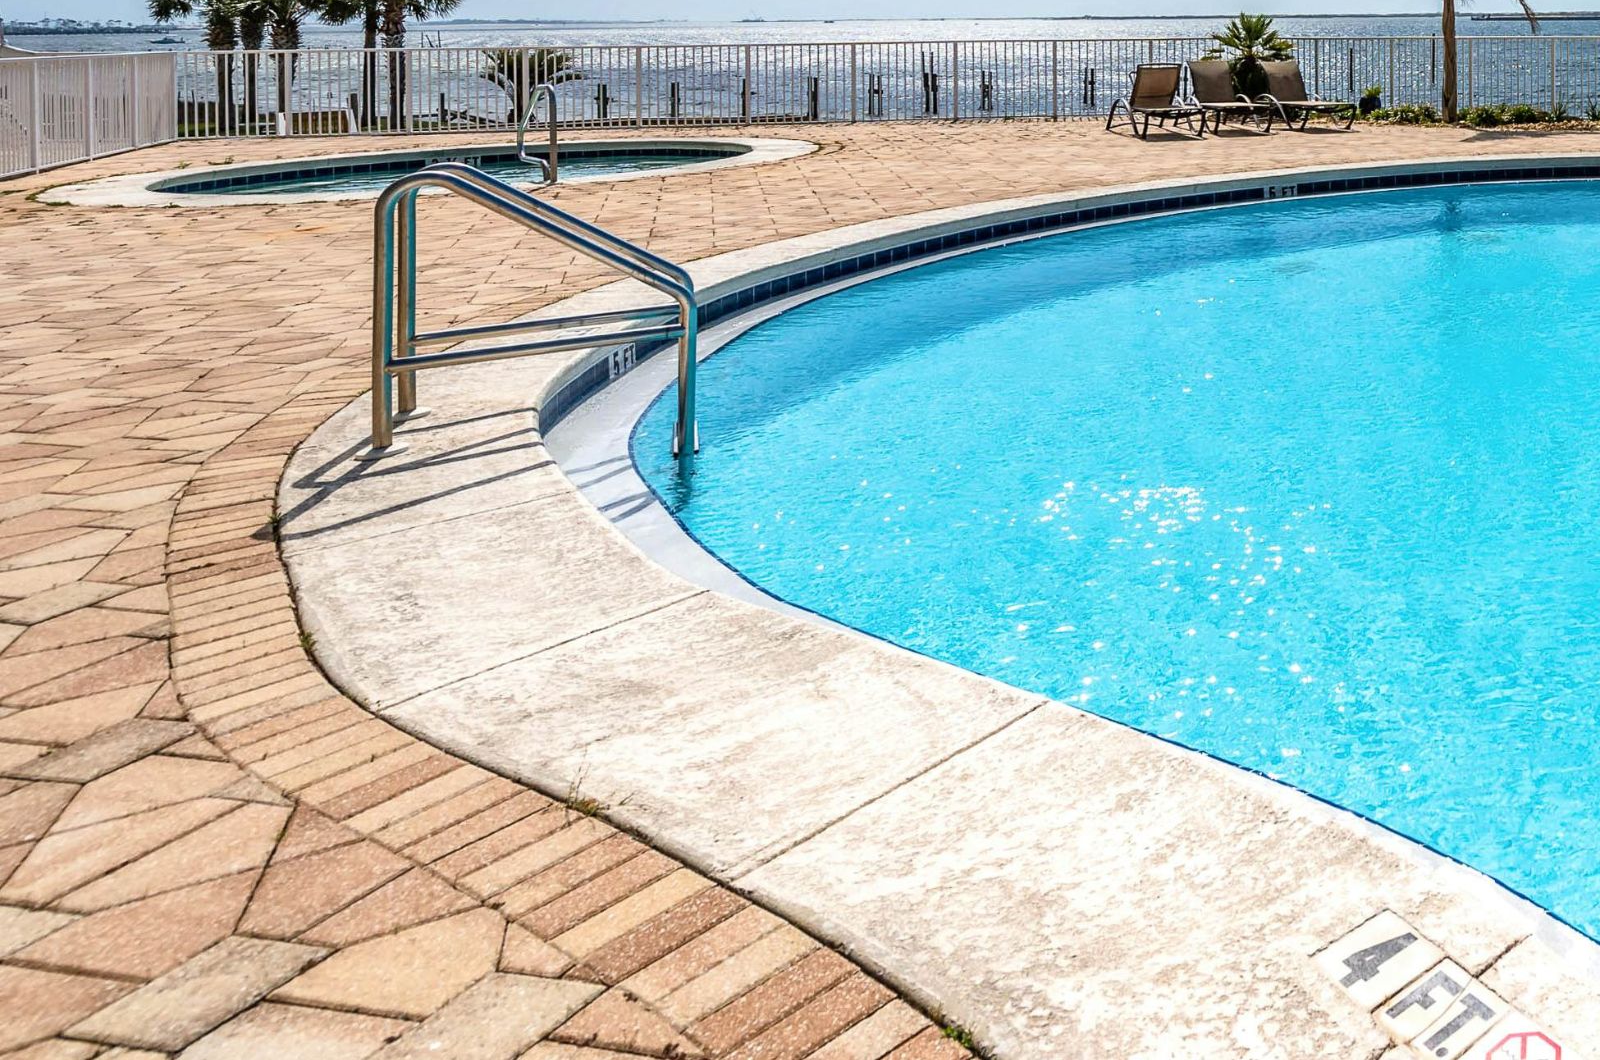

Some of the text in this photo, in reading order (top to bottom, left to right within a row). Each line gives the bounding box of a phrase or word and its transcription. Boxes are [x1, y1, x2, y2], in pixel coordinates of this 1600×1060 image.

[1282, 185, 1296, 197] FT
[613, 344, 634, 375] 5 FT
[1339, 931, 1418, 989] 4
